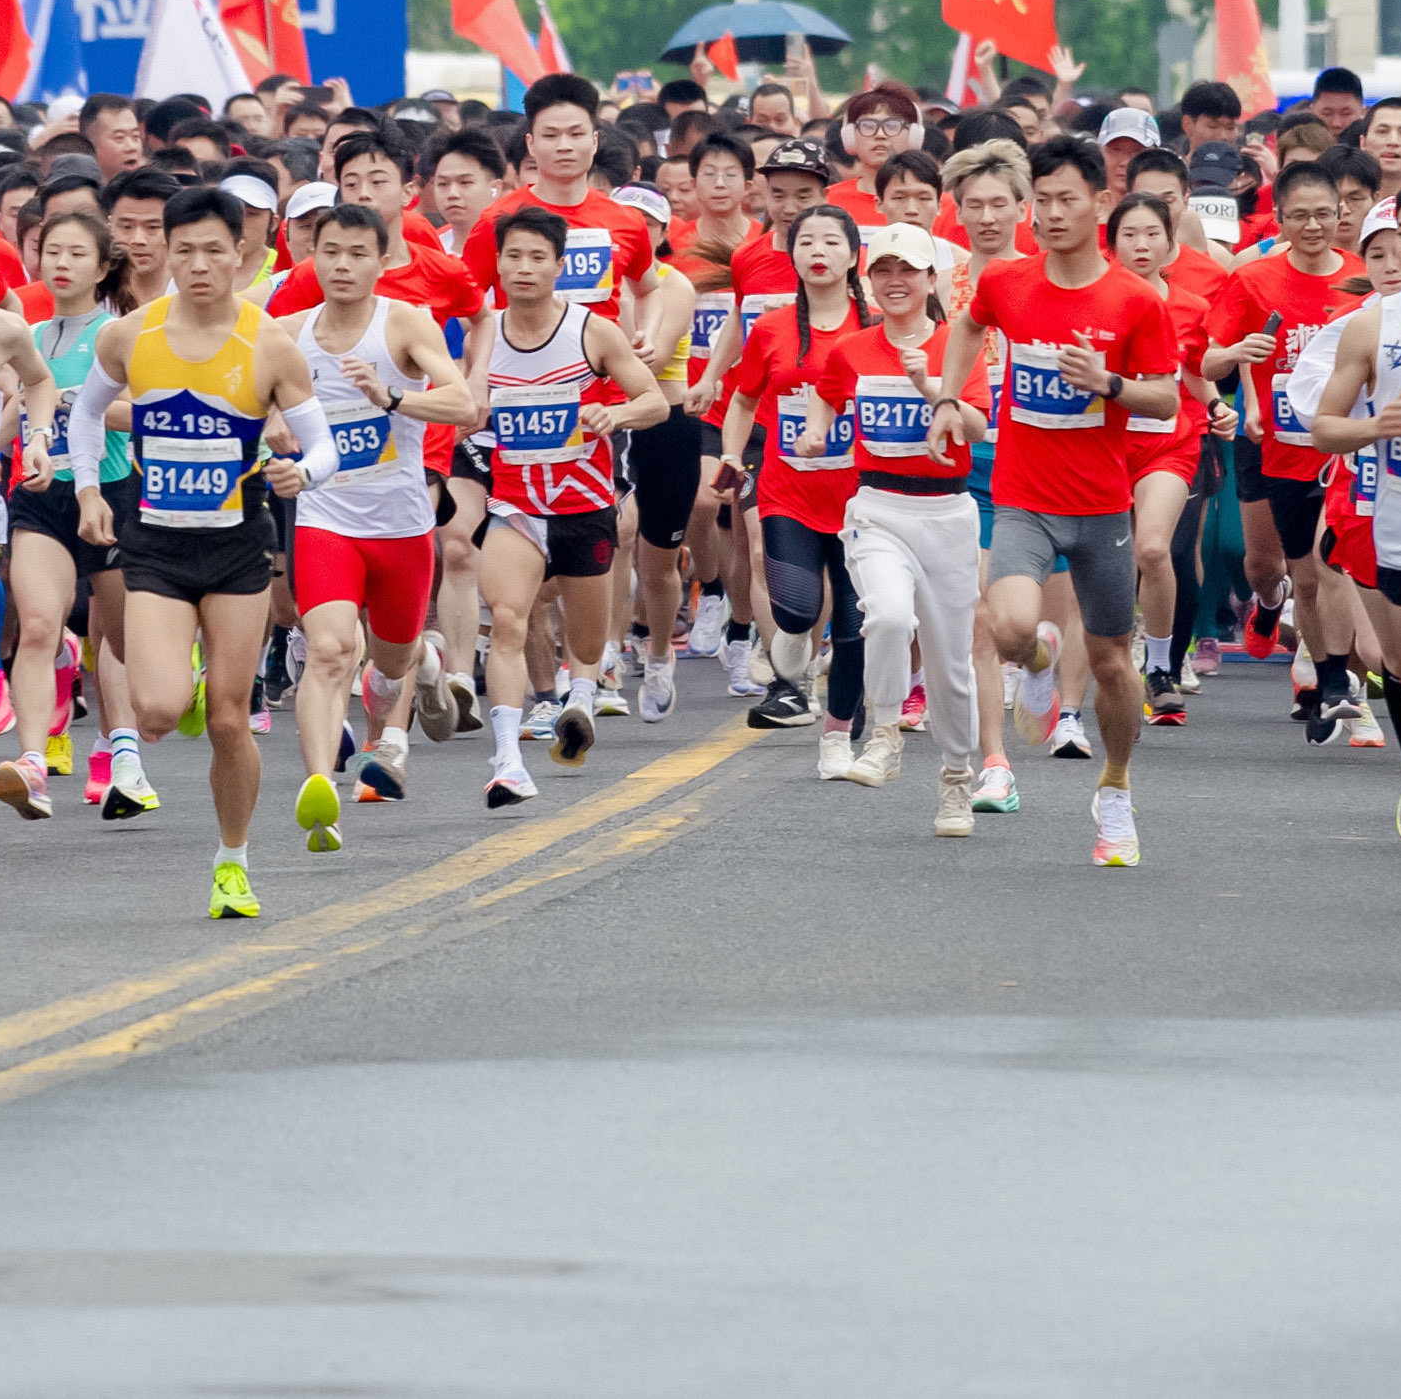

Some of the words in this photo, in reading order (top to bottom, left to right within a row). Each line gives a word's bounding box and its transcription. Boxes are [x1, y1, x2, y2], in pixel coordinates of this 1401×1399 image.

[1190, 202, 1236, 218] PORT
[142, 410, 233, 437] 42.195
[497, 409, 570, 436] B1457
[859, 402, 935, 428] B2178
[146, 465, 230, 496] B1449
